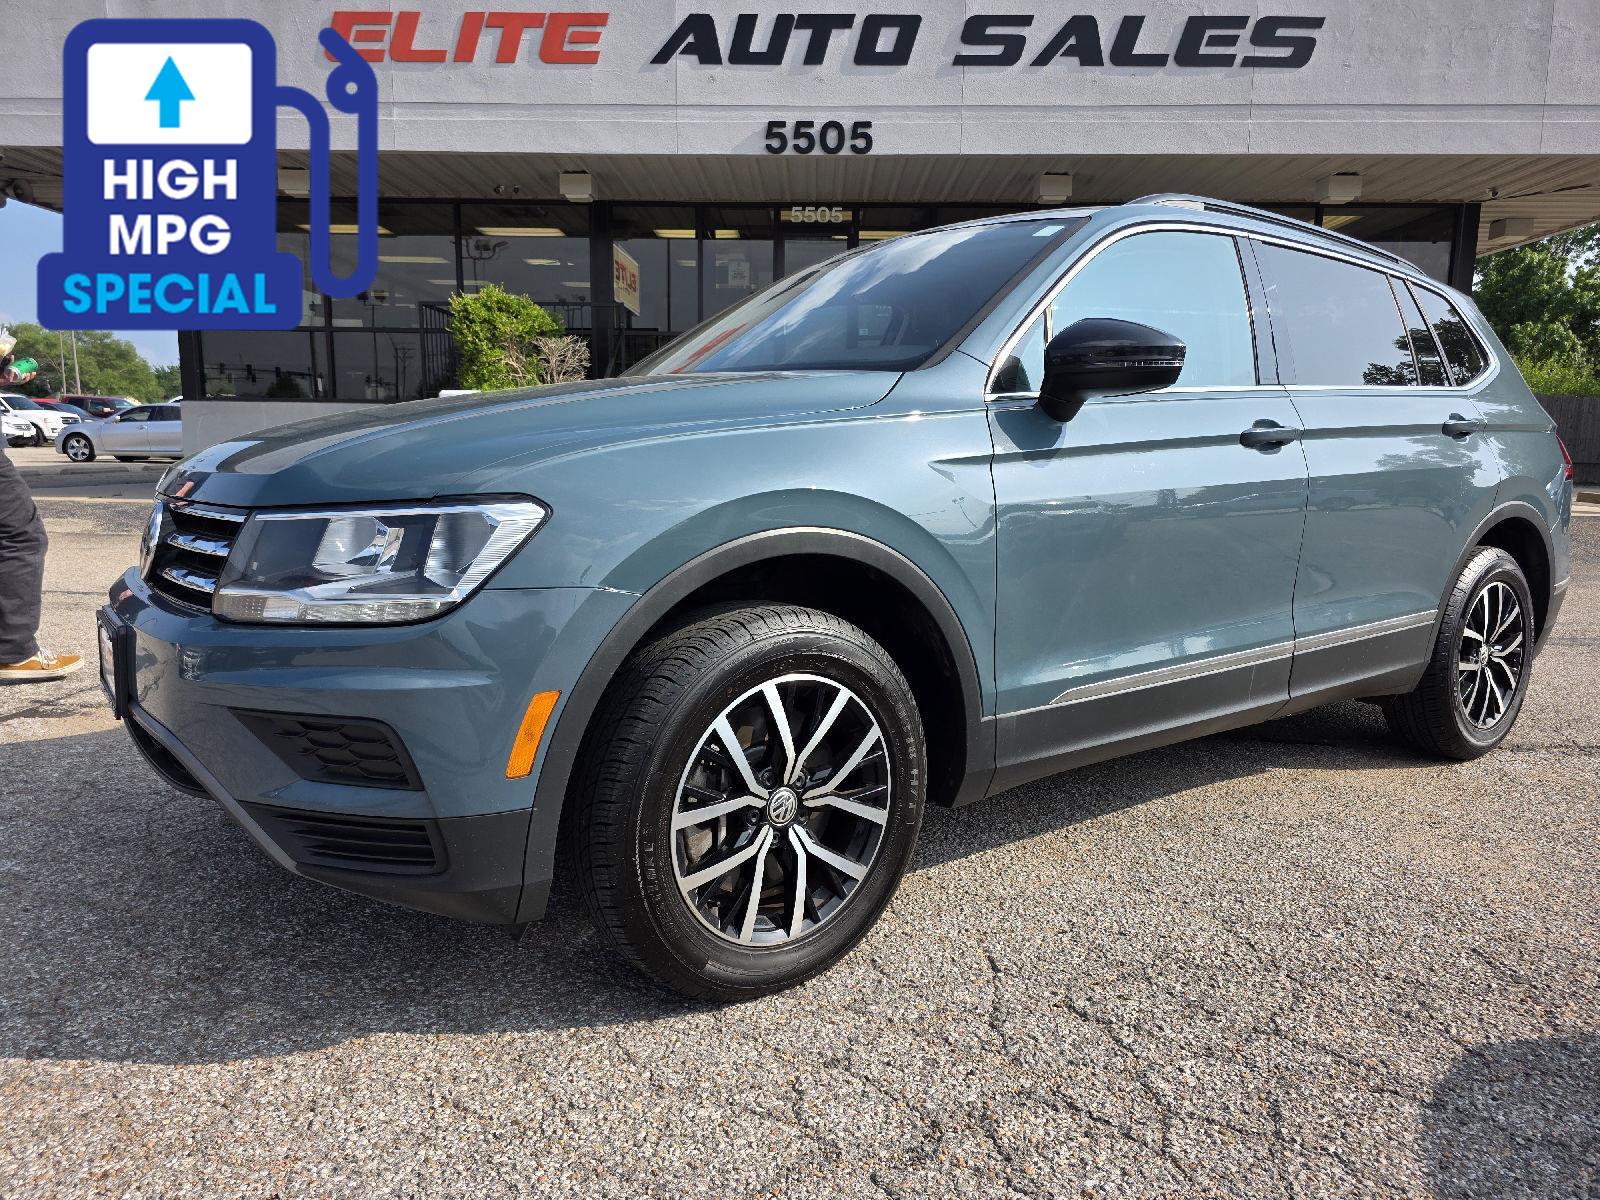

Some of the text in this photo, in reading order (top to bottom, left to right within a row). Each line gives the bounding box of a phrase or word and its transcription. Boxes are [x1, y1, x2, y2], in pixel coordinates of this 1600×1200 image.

[324, 11, 1326, 69] ELITE AUTO SALES
[764, 121, 874, 155] 5505
[791, 206, 843, 223] 5505
